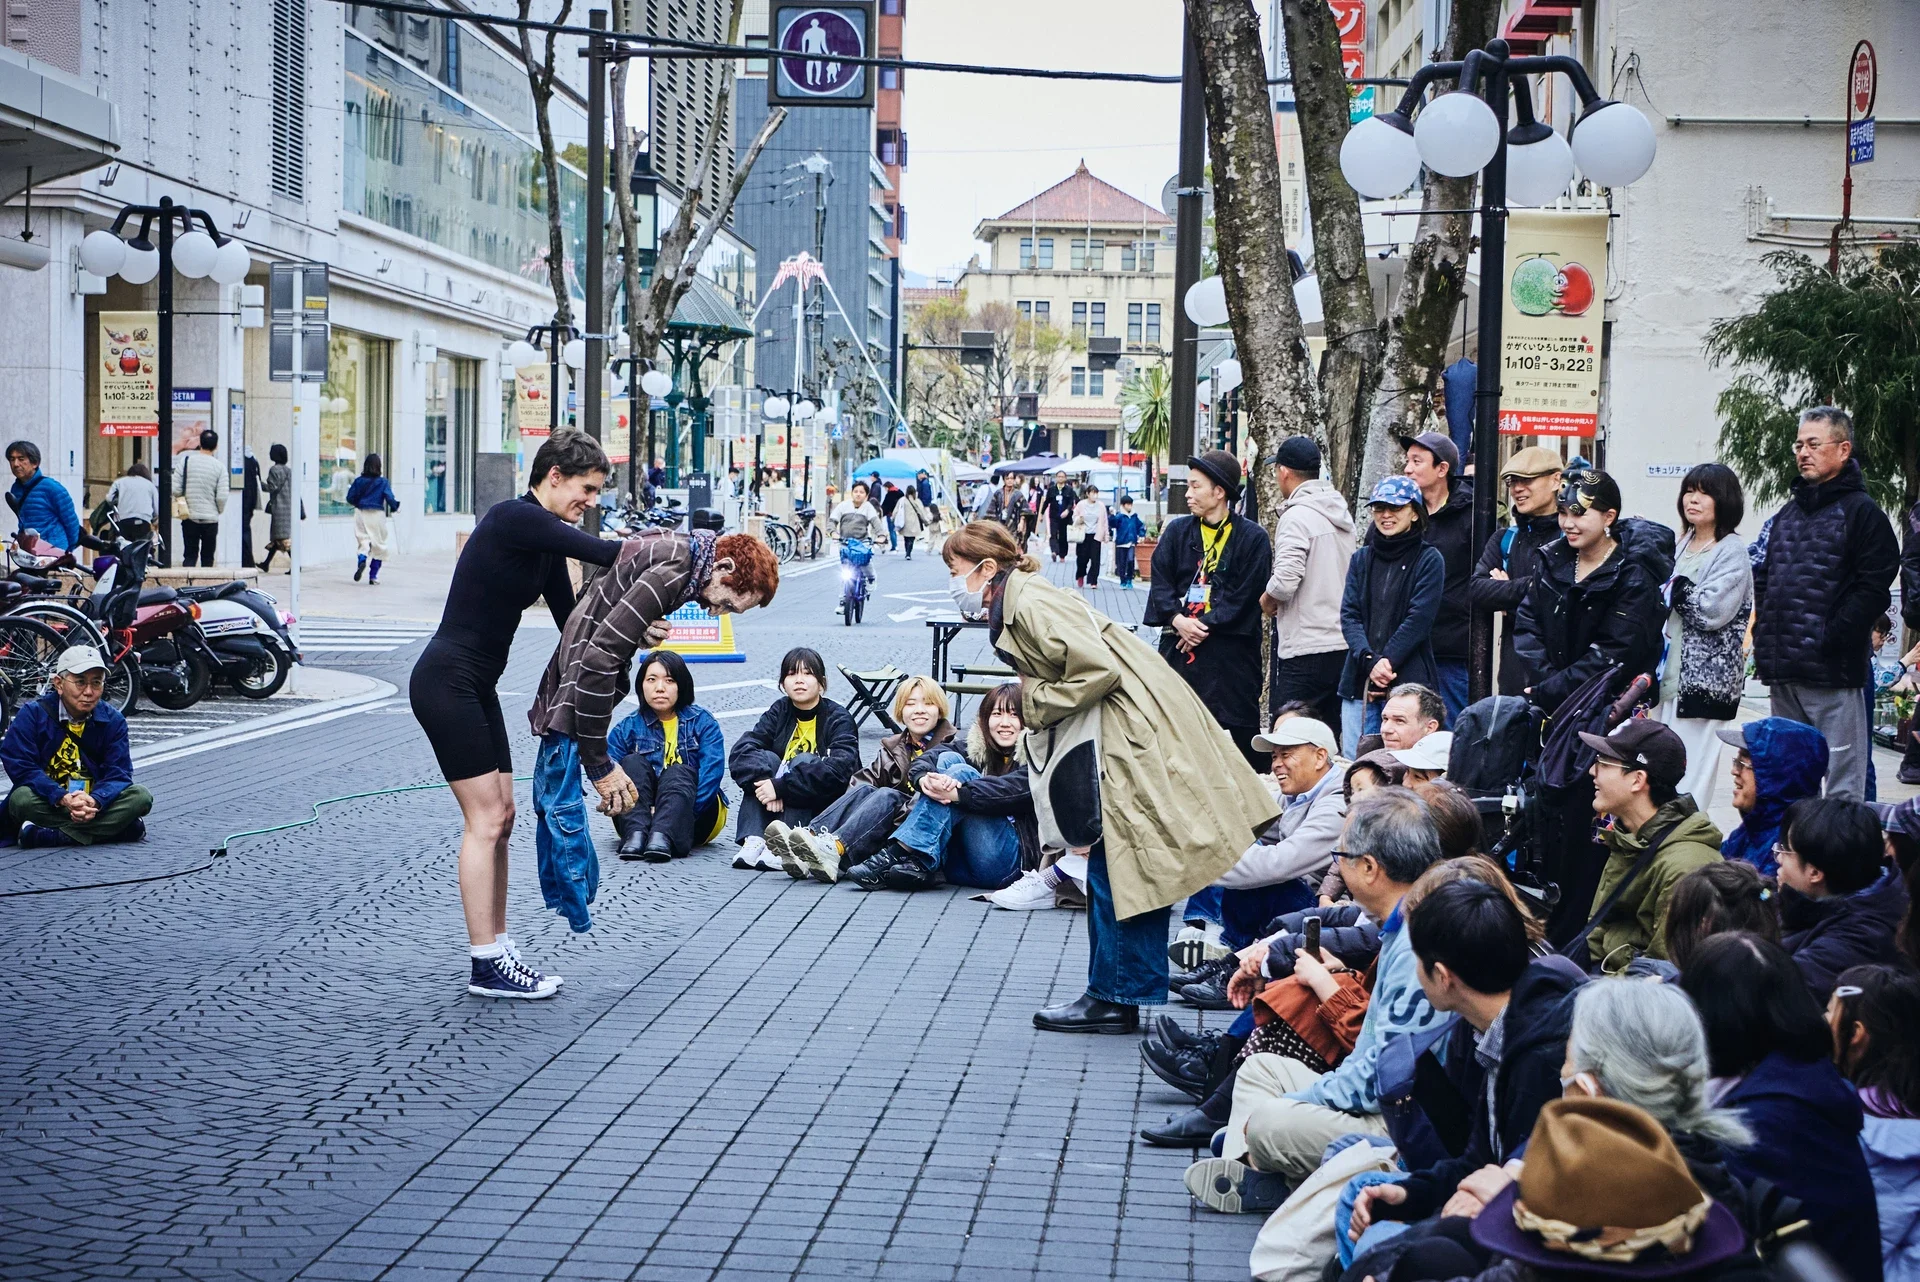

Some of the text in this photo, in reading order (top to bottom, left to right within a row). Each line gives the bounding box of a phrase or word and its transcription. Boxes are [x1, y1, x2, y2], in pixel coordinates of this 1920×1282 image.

[1855, 71, 1869, 94] 消火栓
[1857, 145, 1873, 161] クリニック
[1506, 343, 1594, 354] かがくいひろしの世界展
[1514, 397, 1568, 407] 静岡市美術館
[1648, 466, 1693, 475] セキュリティ
